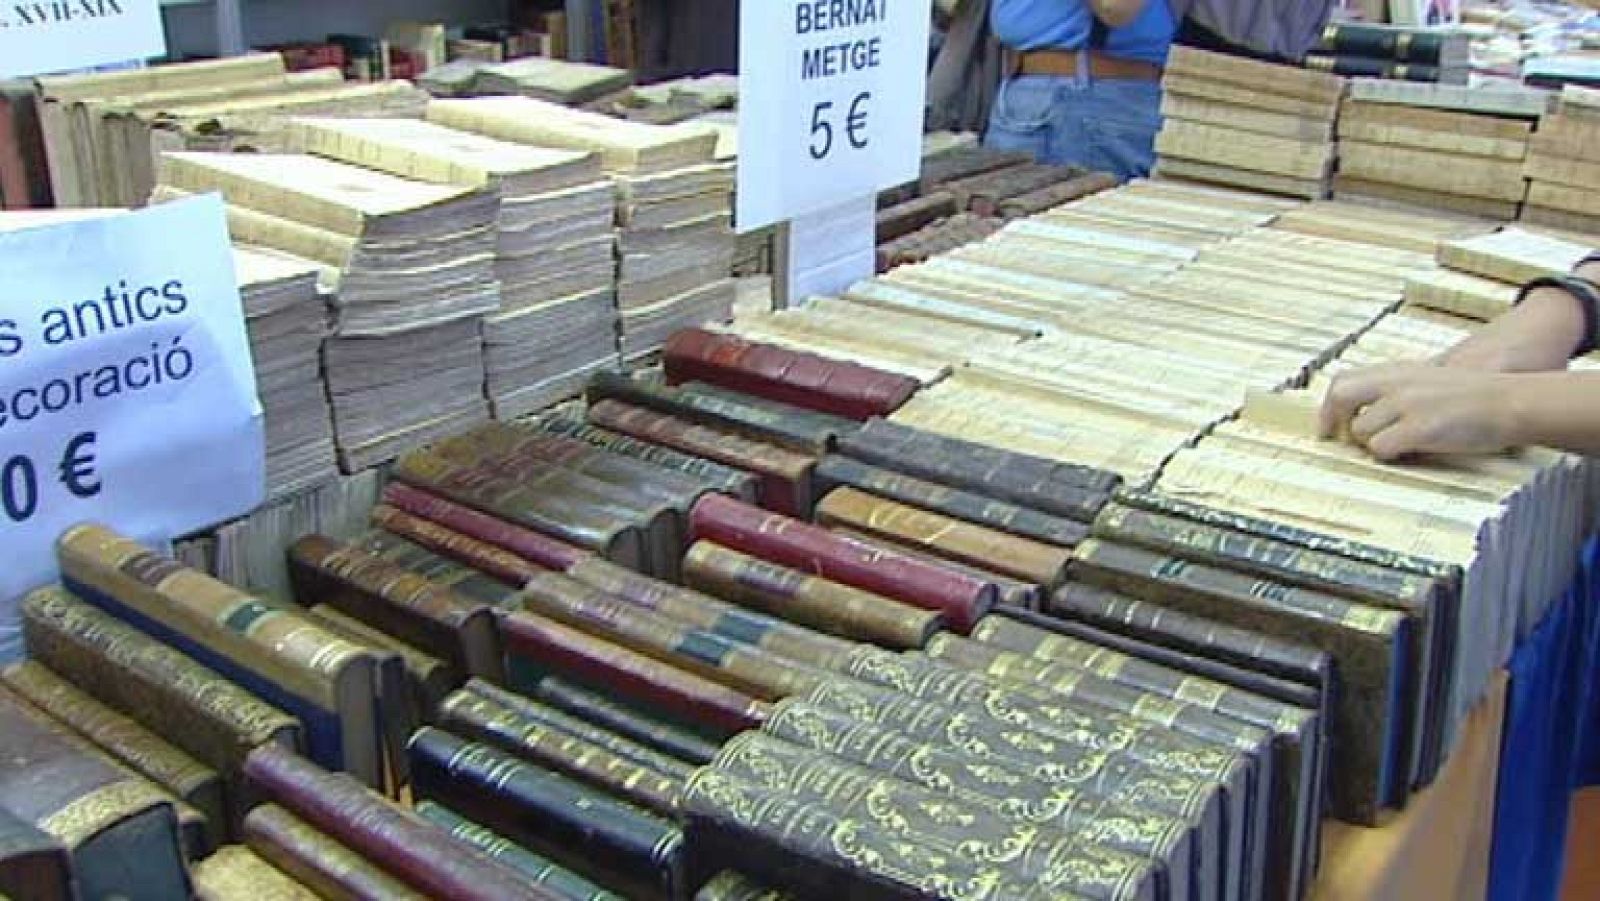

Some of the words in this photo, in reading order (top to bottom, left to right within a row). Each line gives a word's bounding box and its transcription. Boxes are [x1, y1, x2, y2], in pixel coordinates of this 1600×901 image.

[801, 37, 881, 80] METGE
[809, 101, 834, 160] 5
[845, 91, 871, 149] €
[41, 279, 188, 345] antics
[0, 335, 193, 428] coració
[59, 431, 103, 498] €
